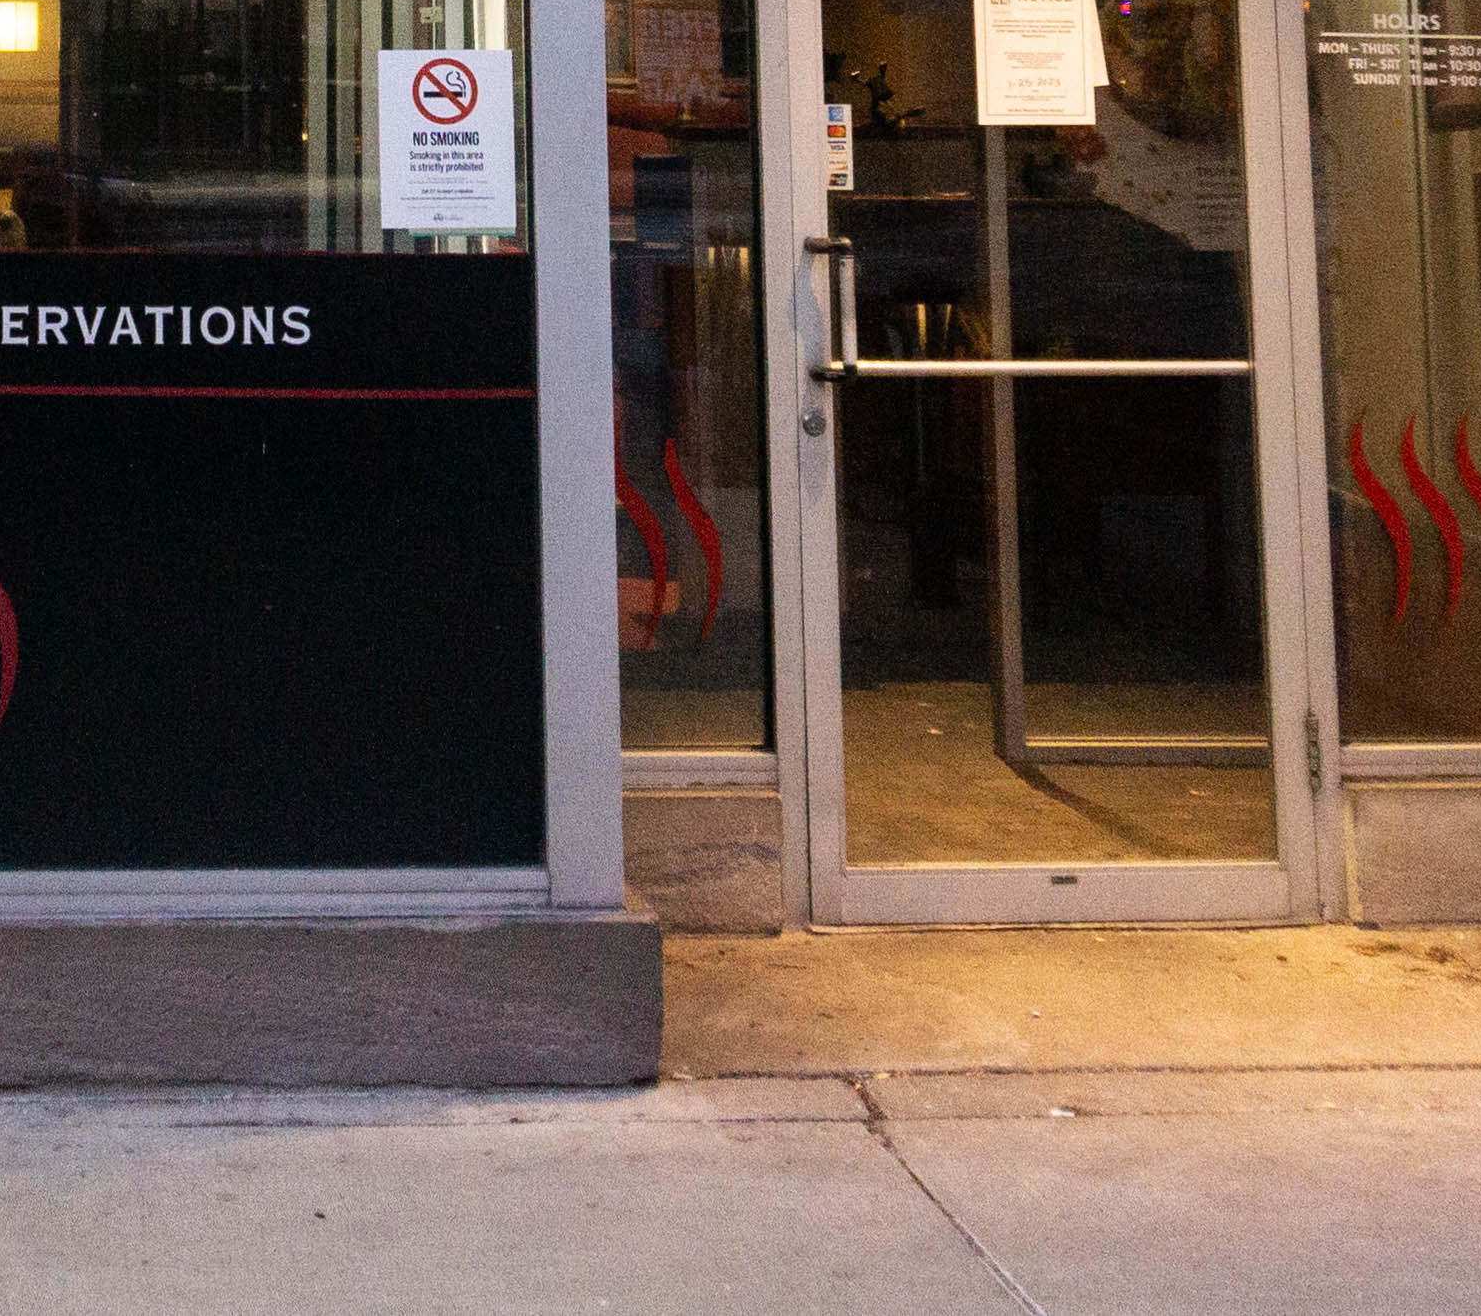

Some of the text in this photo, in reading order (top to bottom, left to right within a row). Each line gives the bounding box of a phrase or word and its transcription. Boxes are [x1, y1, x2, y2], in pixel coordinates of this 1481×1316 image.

[1372, 13, 1441, 31] HOURS
[1318, 42, 1349, 54] MON
[1448, 45, 1474, 57] 9:30
[1349, 57, 1367, 70] FRI
[1379, 58, 1401, 70] SAT
[1450, 60, 1481, 72] 10:30
[1352, 73, 1402, 86] SUNDAY
[1449, 75, 1477, 87] 9:00
[412, 131, 480, 146] NO SMOKING
[409, 150, 484, 162] Smoking in this area
[418, 162, 444, 173] strictly
[445, 162, 484, 173] prohibited
